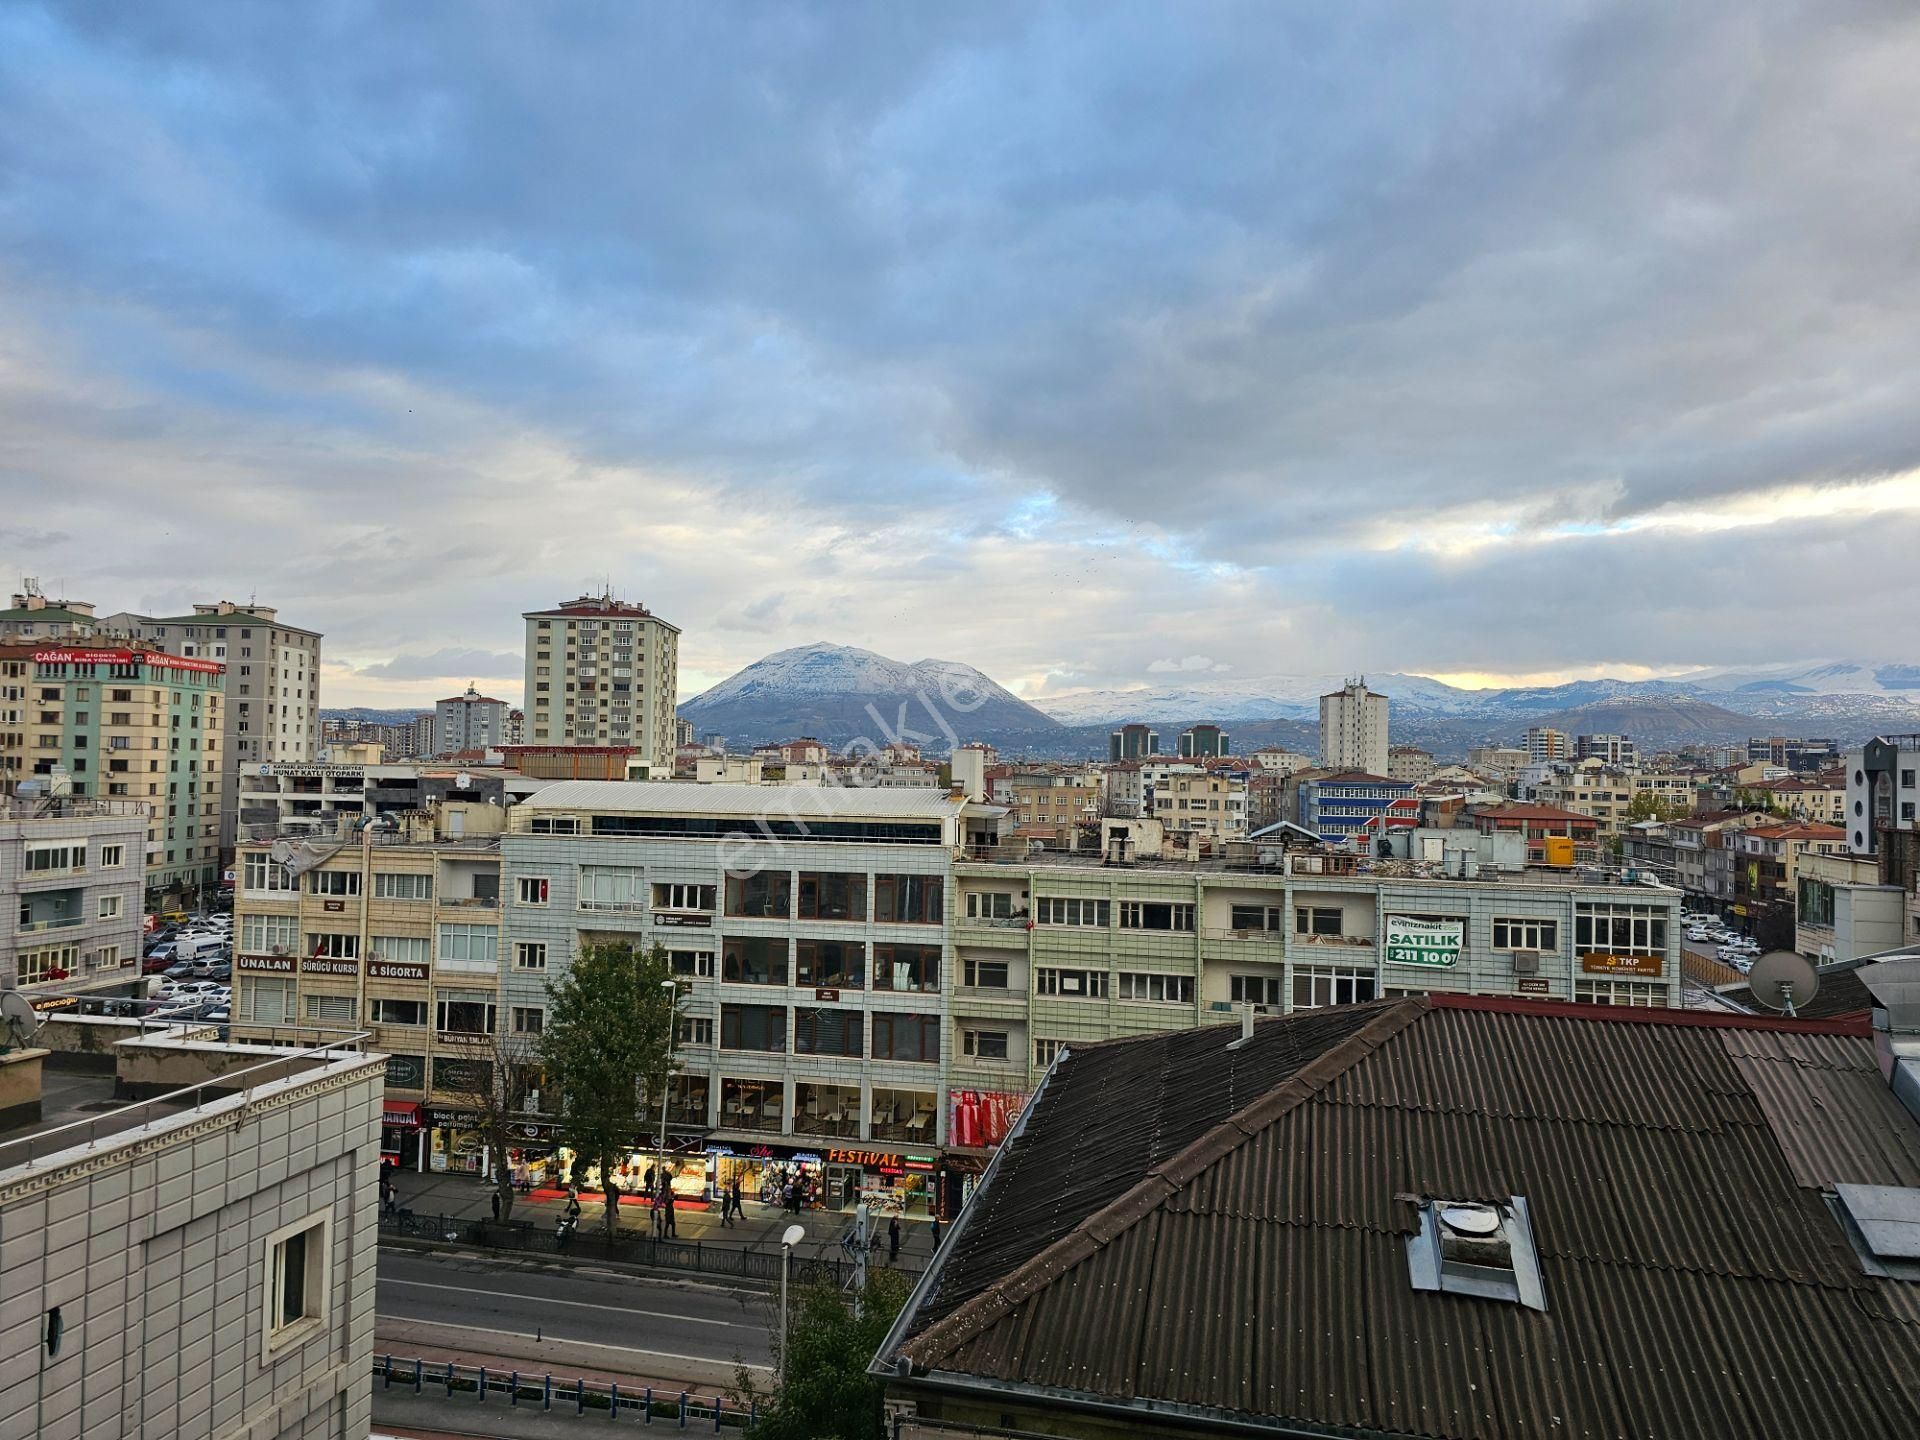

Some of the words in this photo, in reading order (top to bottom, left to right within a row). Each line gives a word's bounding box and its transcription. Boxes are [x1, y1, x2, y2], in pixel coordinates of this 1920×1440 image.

[1389, 933, 1459, 946] SATILIK
[1395, 948, 1418, 961] 211
[1422, 951, 1440, 963] 10
[1618, 957, 1640, 966] TKP
[240, 957, 291, 971] ÜNALAN
[302, 961, 331, 972] SÜRÜCÜ
[332, 963, 358, 974] KURSU
[370, 966, 377, 975] &
[380, 966, 423, 978] SİGORTA
[433, 1111, 455, 1121] black
[750, 1143, 774, 1157] She
